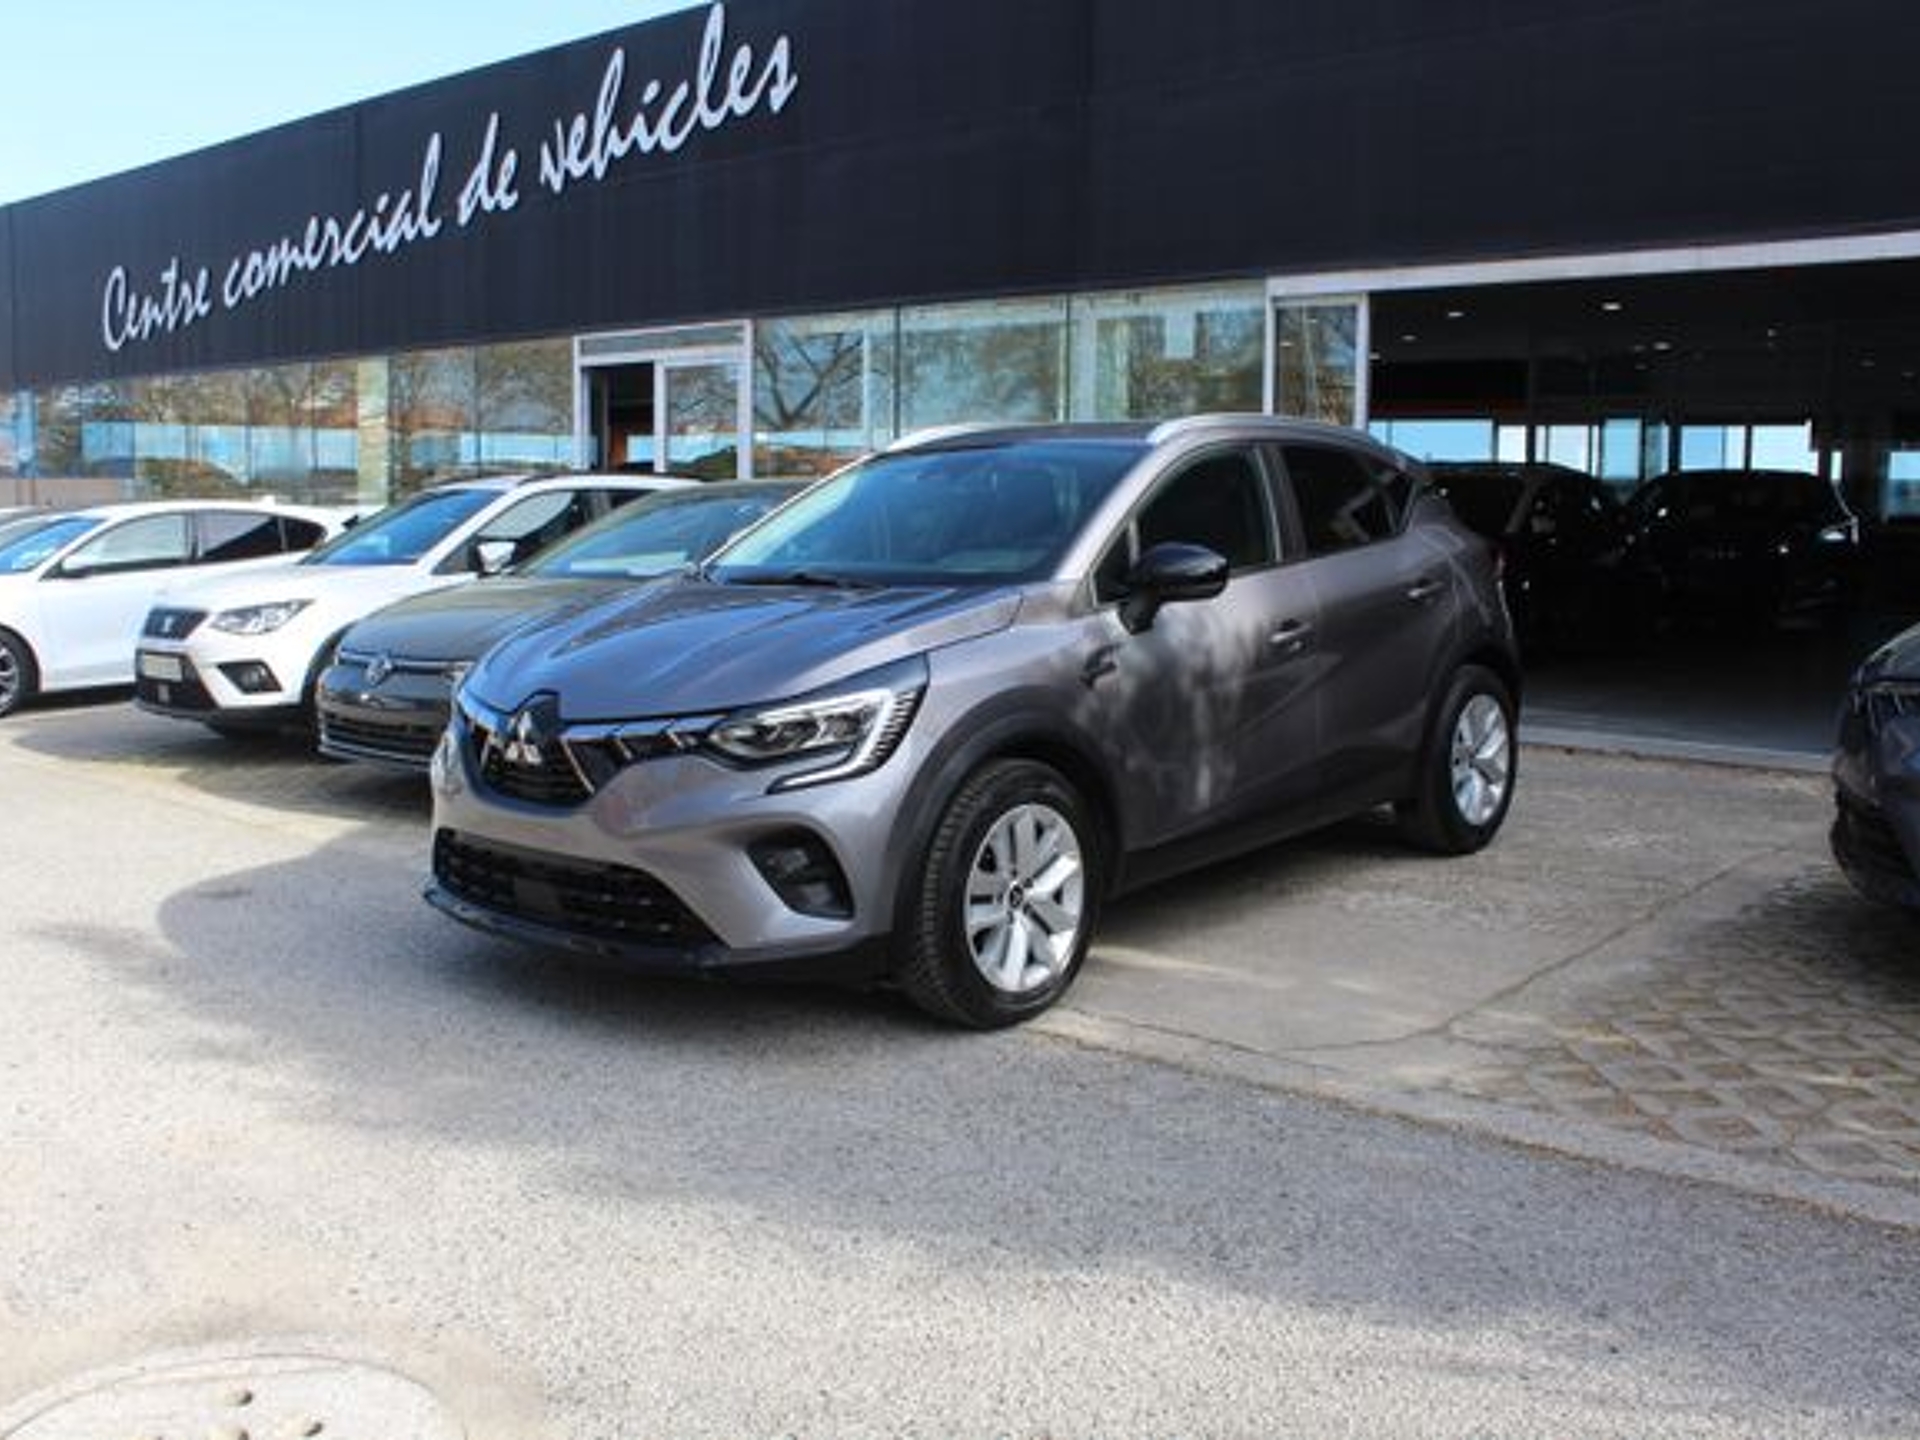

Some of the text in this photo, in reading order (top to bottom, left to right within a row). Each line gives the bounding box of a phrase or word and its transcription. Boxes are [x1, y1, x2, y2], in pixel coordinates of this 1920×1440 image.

[102, 2, 798, 351] Centre comercial de vehicles
